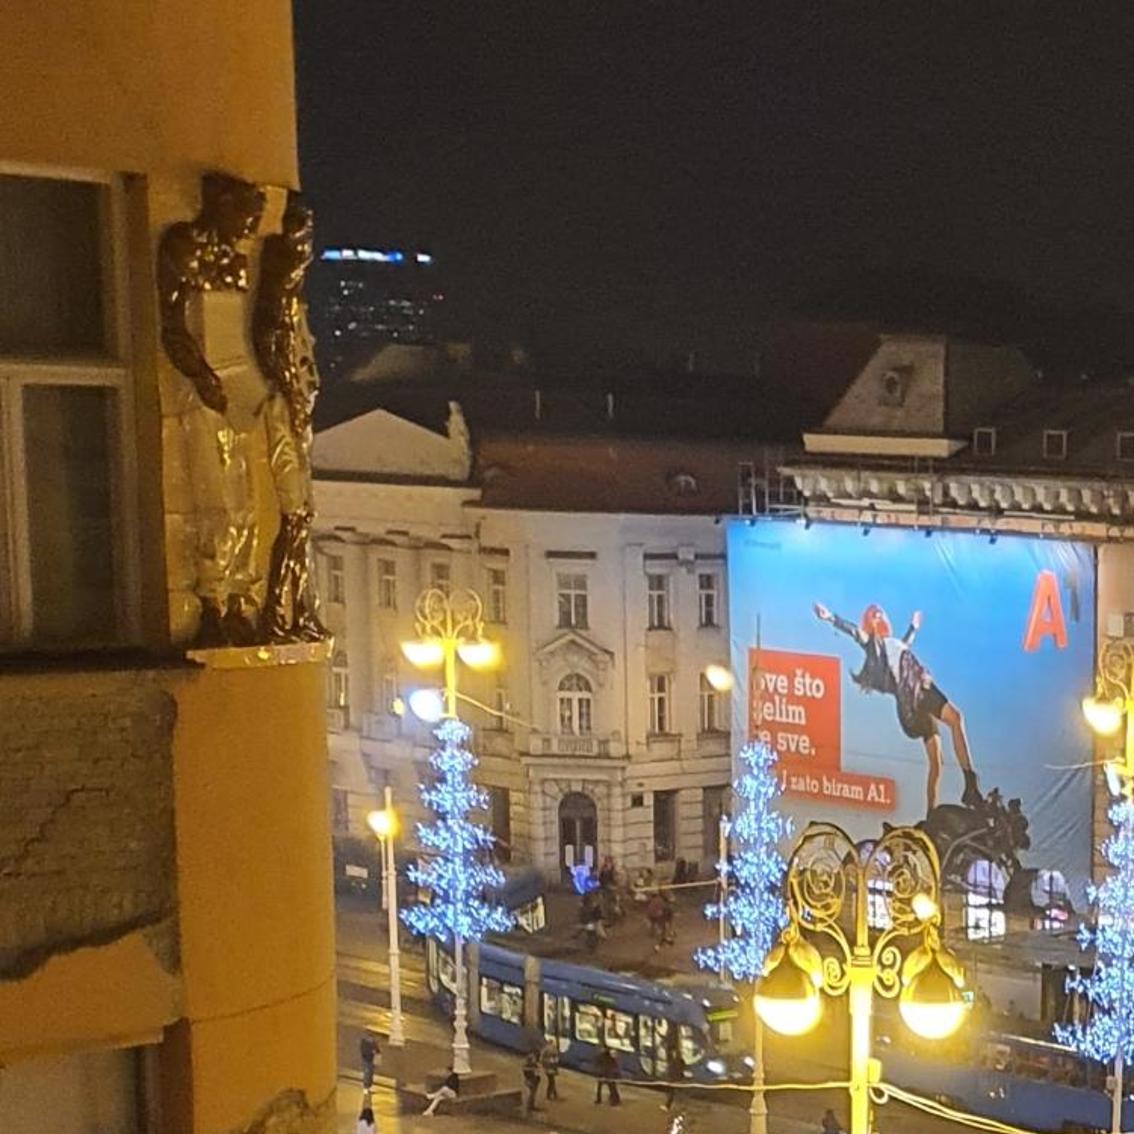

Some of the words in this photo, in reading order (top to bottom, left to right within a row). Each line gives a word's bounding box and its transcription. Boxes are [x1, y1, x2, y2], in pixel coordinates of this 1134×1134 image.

[794, 668, 825, 699] što
[777, 731, 816, 756] sve.
[790, 774, 819, 793] zato
[822, 774, 864, 801] biram
